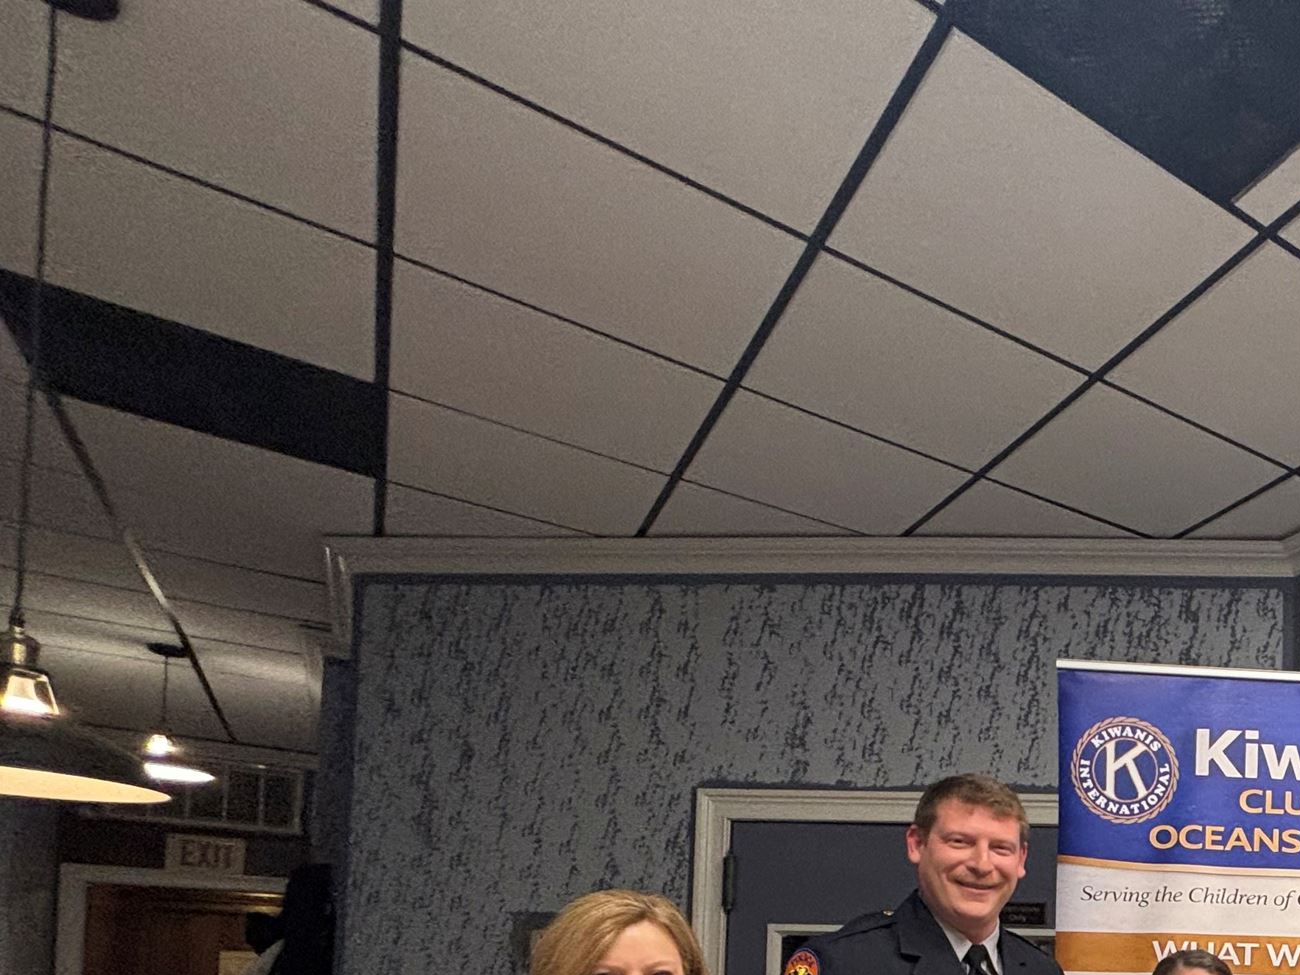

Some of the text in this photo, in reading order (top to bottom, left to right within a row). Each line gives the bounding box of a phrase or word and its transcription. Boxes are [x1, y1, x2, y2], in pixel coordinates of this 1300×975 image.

[1090, 726, 1162, 752] KIWANIS
[1079, 758, 1171, 815] INTERNATIONAL
[180, 841, 233, 868] EXIT
[1080, 885, 1150, 908] Serving
[1154, 886, 1184, 903] the
[1188, 886, 1268, 906] Children
[1273, 889, 1297, 912] of
